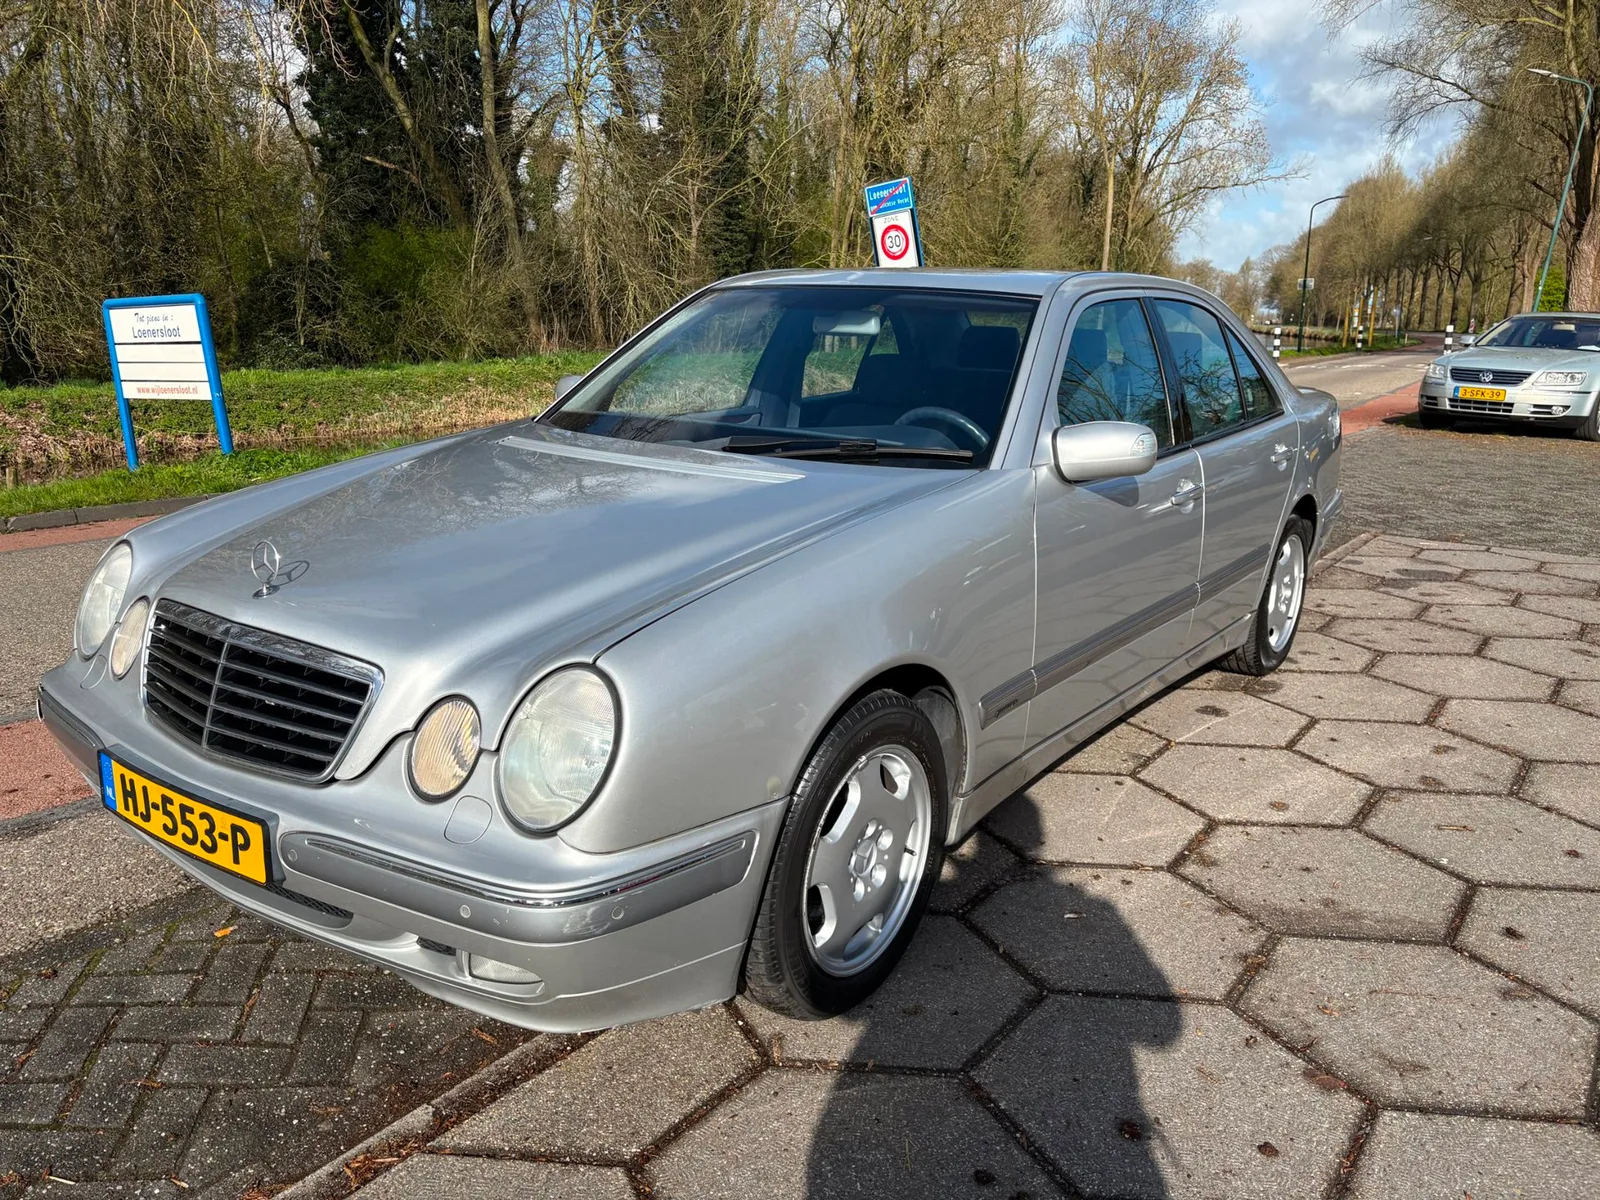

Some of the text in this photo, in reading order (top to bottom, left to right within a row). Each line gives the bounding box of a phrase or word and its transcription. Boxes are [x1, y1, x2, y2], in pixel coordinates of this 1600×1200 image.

[883, 215, 899, 224] ZONE
[887, 234, 901, 249] 30
[132, 325, 181, 338] Loenersloot
[1461, 388, 1501, 399] 3-SFK-39
[106, 785, 116, 800] NL
[120, 773, 250, 865] HJ-553-P
